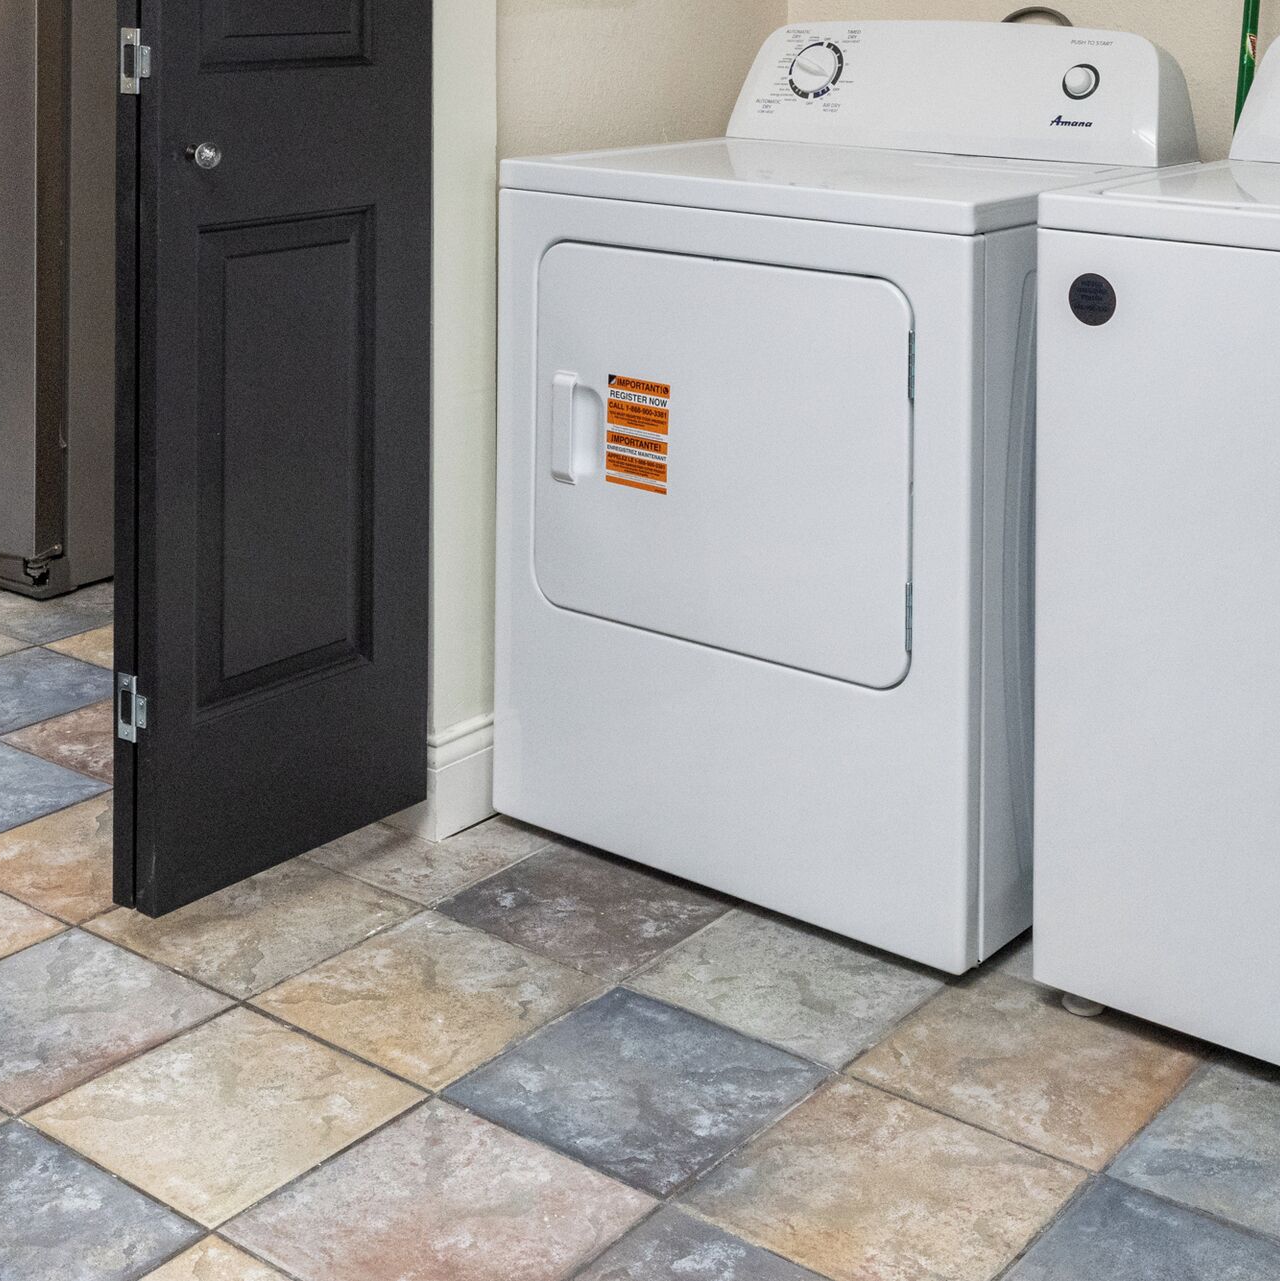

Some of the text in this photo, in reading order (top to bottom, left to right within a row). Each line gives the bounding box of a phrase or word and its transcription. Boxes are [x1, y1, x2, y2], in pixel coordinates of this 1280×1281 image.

[1049, 114, 1093, 128] Amana
[608, 401, 625, 410] CALL
[610, 389, 668, 408] REGISTER NOW
